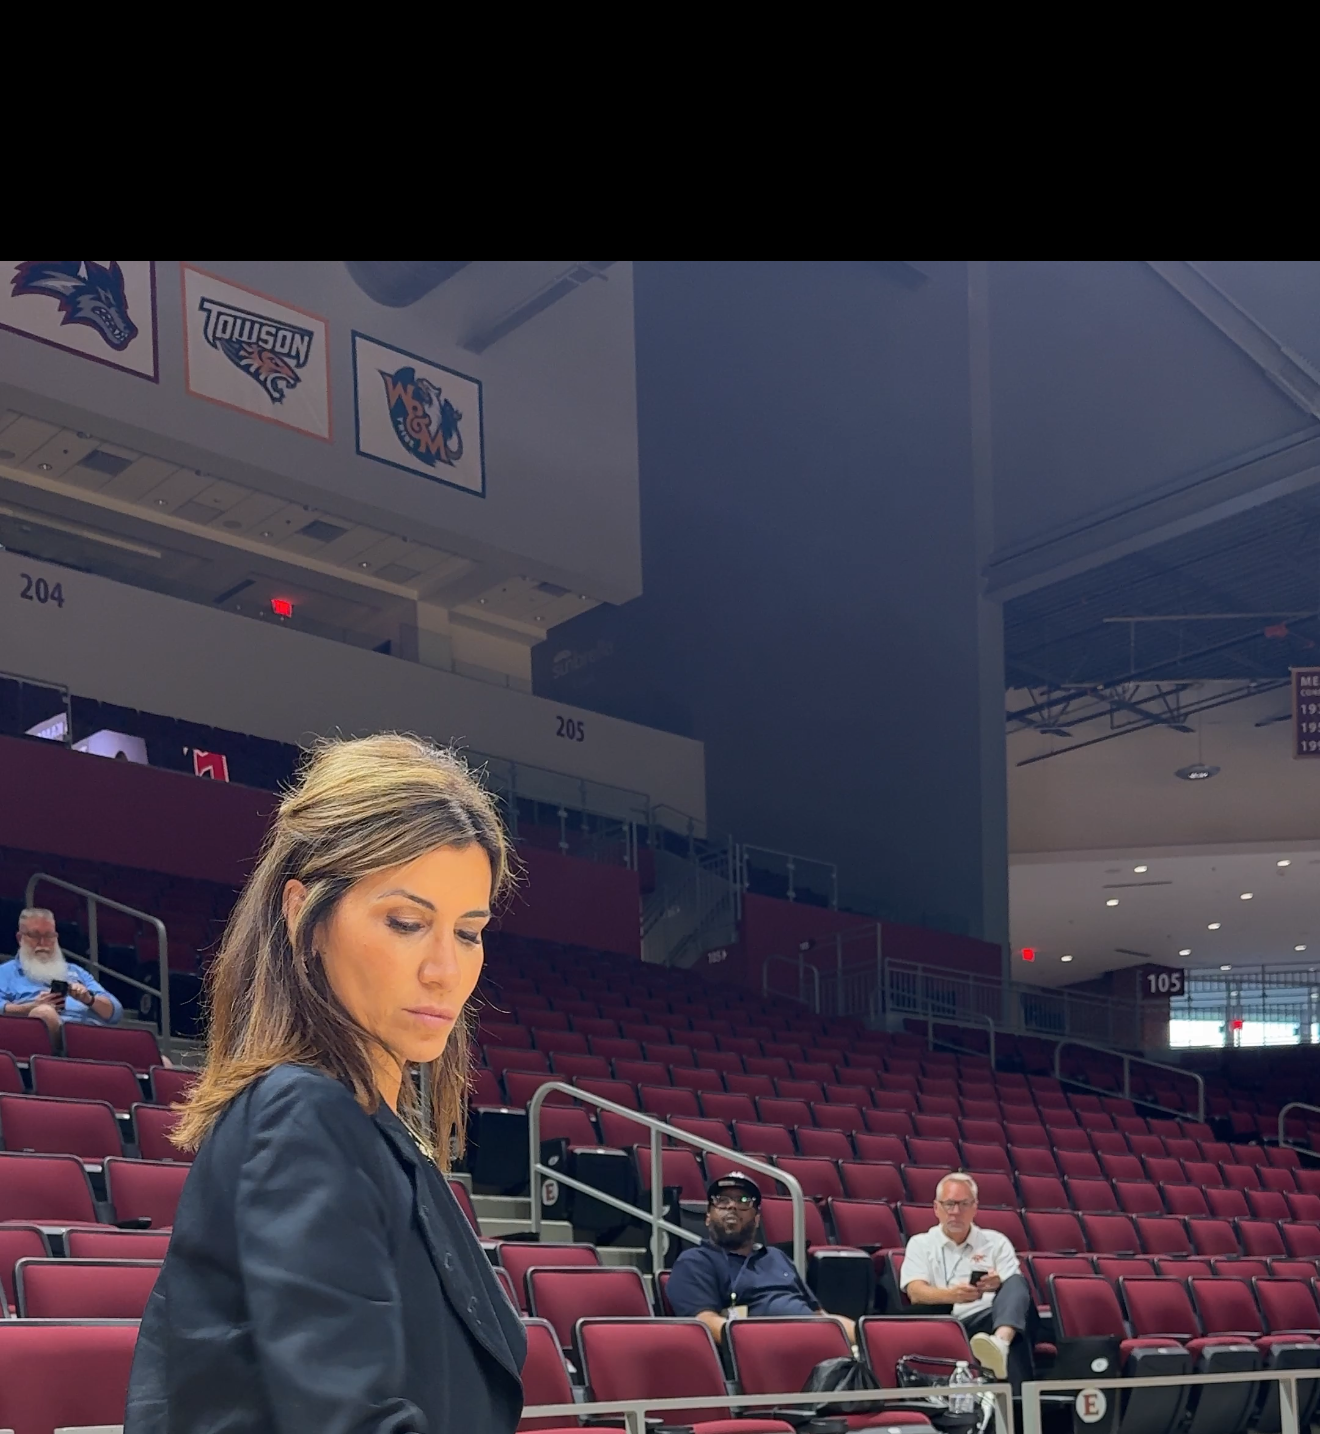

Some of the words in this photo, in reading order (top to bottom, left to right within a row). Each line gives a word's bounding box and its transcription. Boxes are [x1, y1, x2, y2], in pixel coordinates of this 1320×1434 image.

[200, 298, 313, 368] TOWSON
[20, 572, 65, 608] 204
[556, 715, 585, 743] 205
[1147, 973, 1181, 993] 105
[545, 1183, 555, 1202] E
[1083, 1394, 1099, 1415] E
